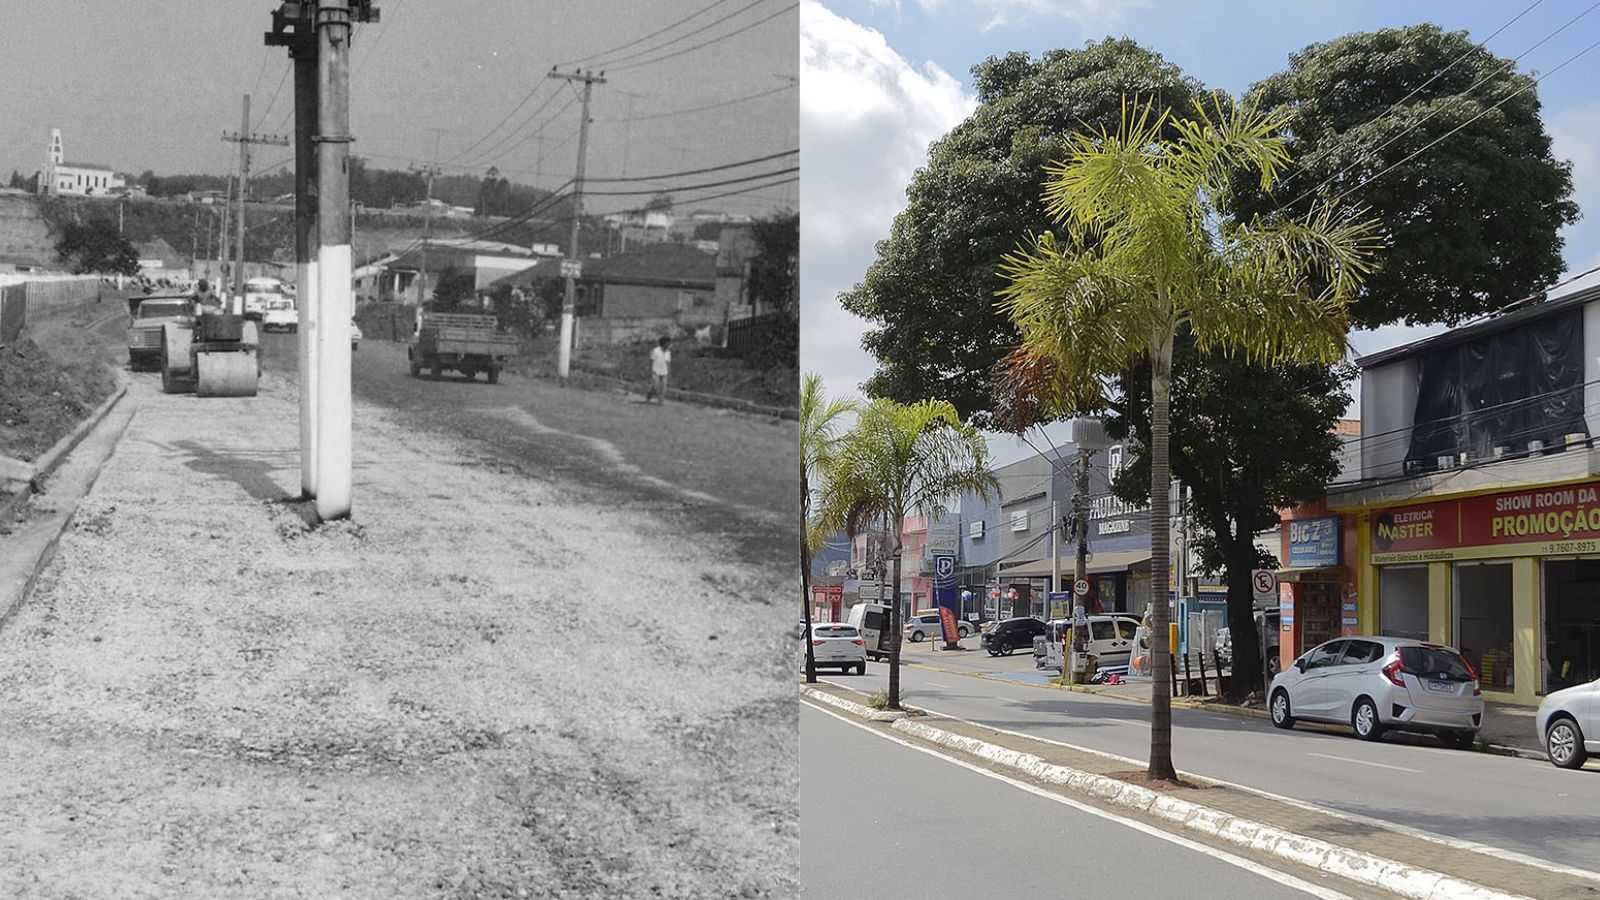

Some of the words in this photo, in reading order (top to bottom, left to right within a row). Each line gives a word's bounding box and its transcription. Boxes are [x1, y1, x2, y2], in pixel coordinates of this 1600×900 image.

[1496, 495, 1532, 511] SHOW
[1536, 490, 1574, 507] ROOM
[1578, 488, 1597, 503] DA
[1378, 522, 1433, 540] MASTER
[1492, 505, 1600, 538] PROMOÇÃO
[1076, 582, 1087, 590] 40
